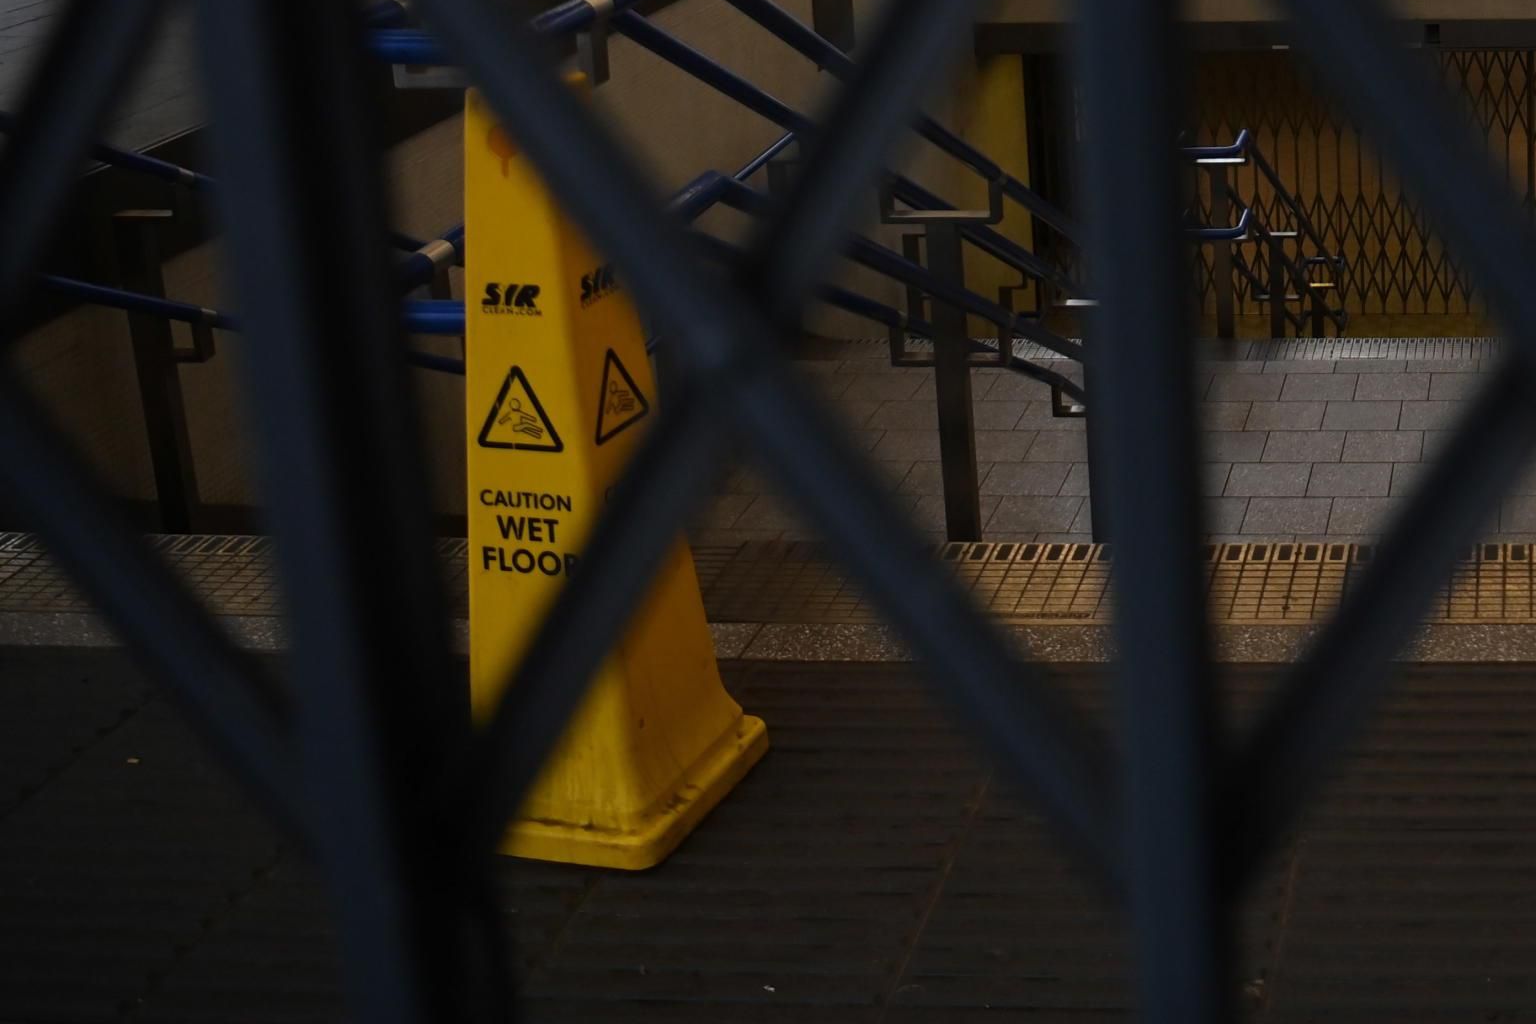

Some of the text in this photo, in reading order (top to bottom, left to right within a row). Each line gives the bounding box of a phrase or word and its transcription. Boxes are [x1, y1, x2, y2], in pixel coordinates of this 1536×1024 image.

[482, 283, 541, 307] SIR
[480, 490, 572, 512] CAUTION
[496, 515, 560, 543] WET
